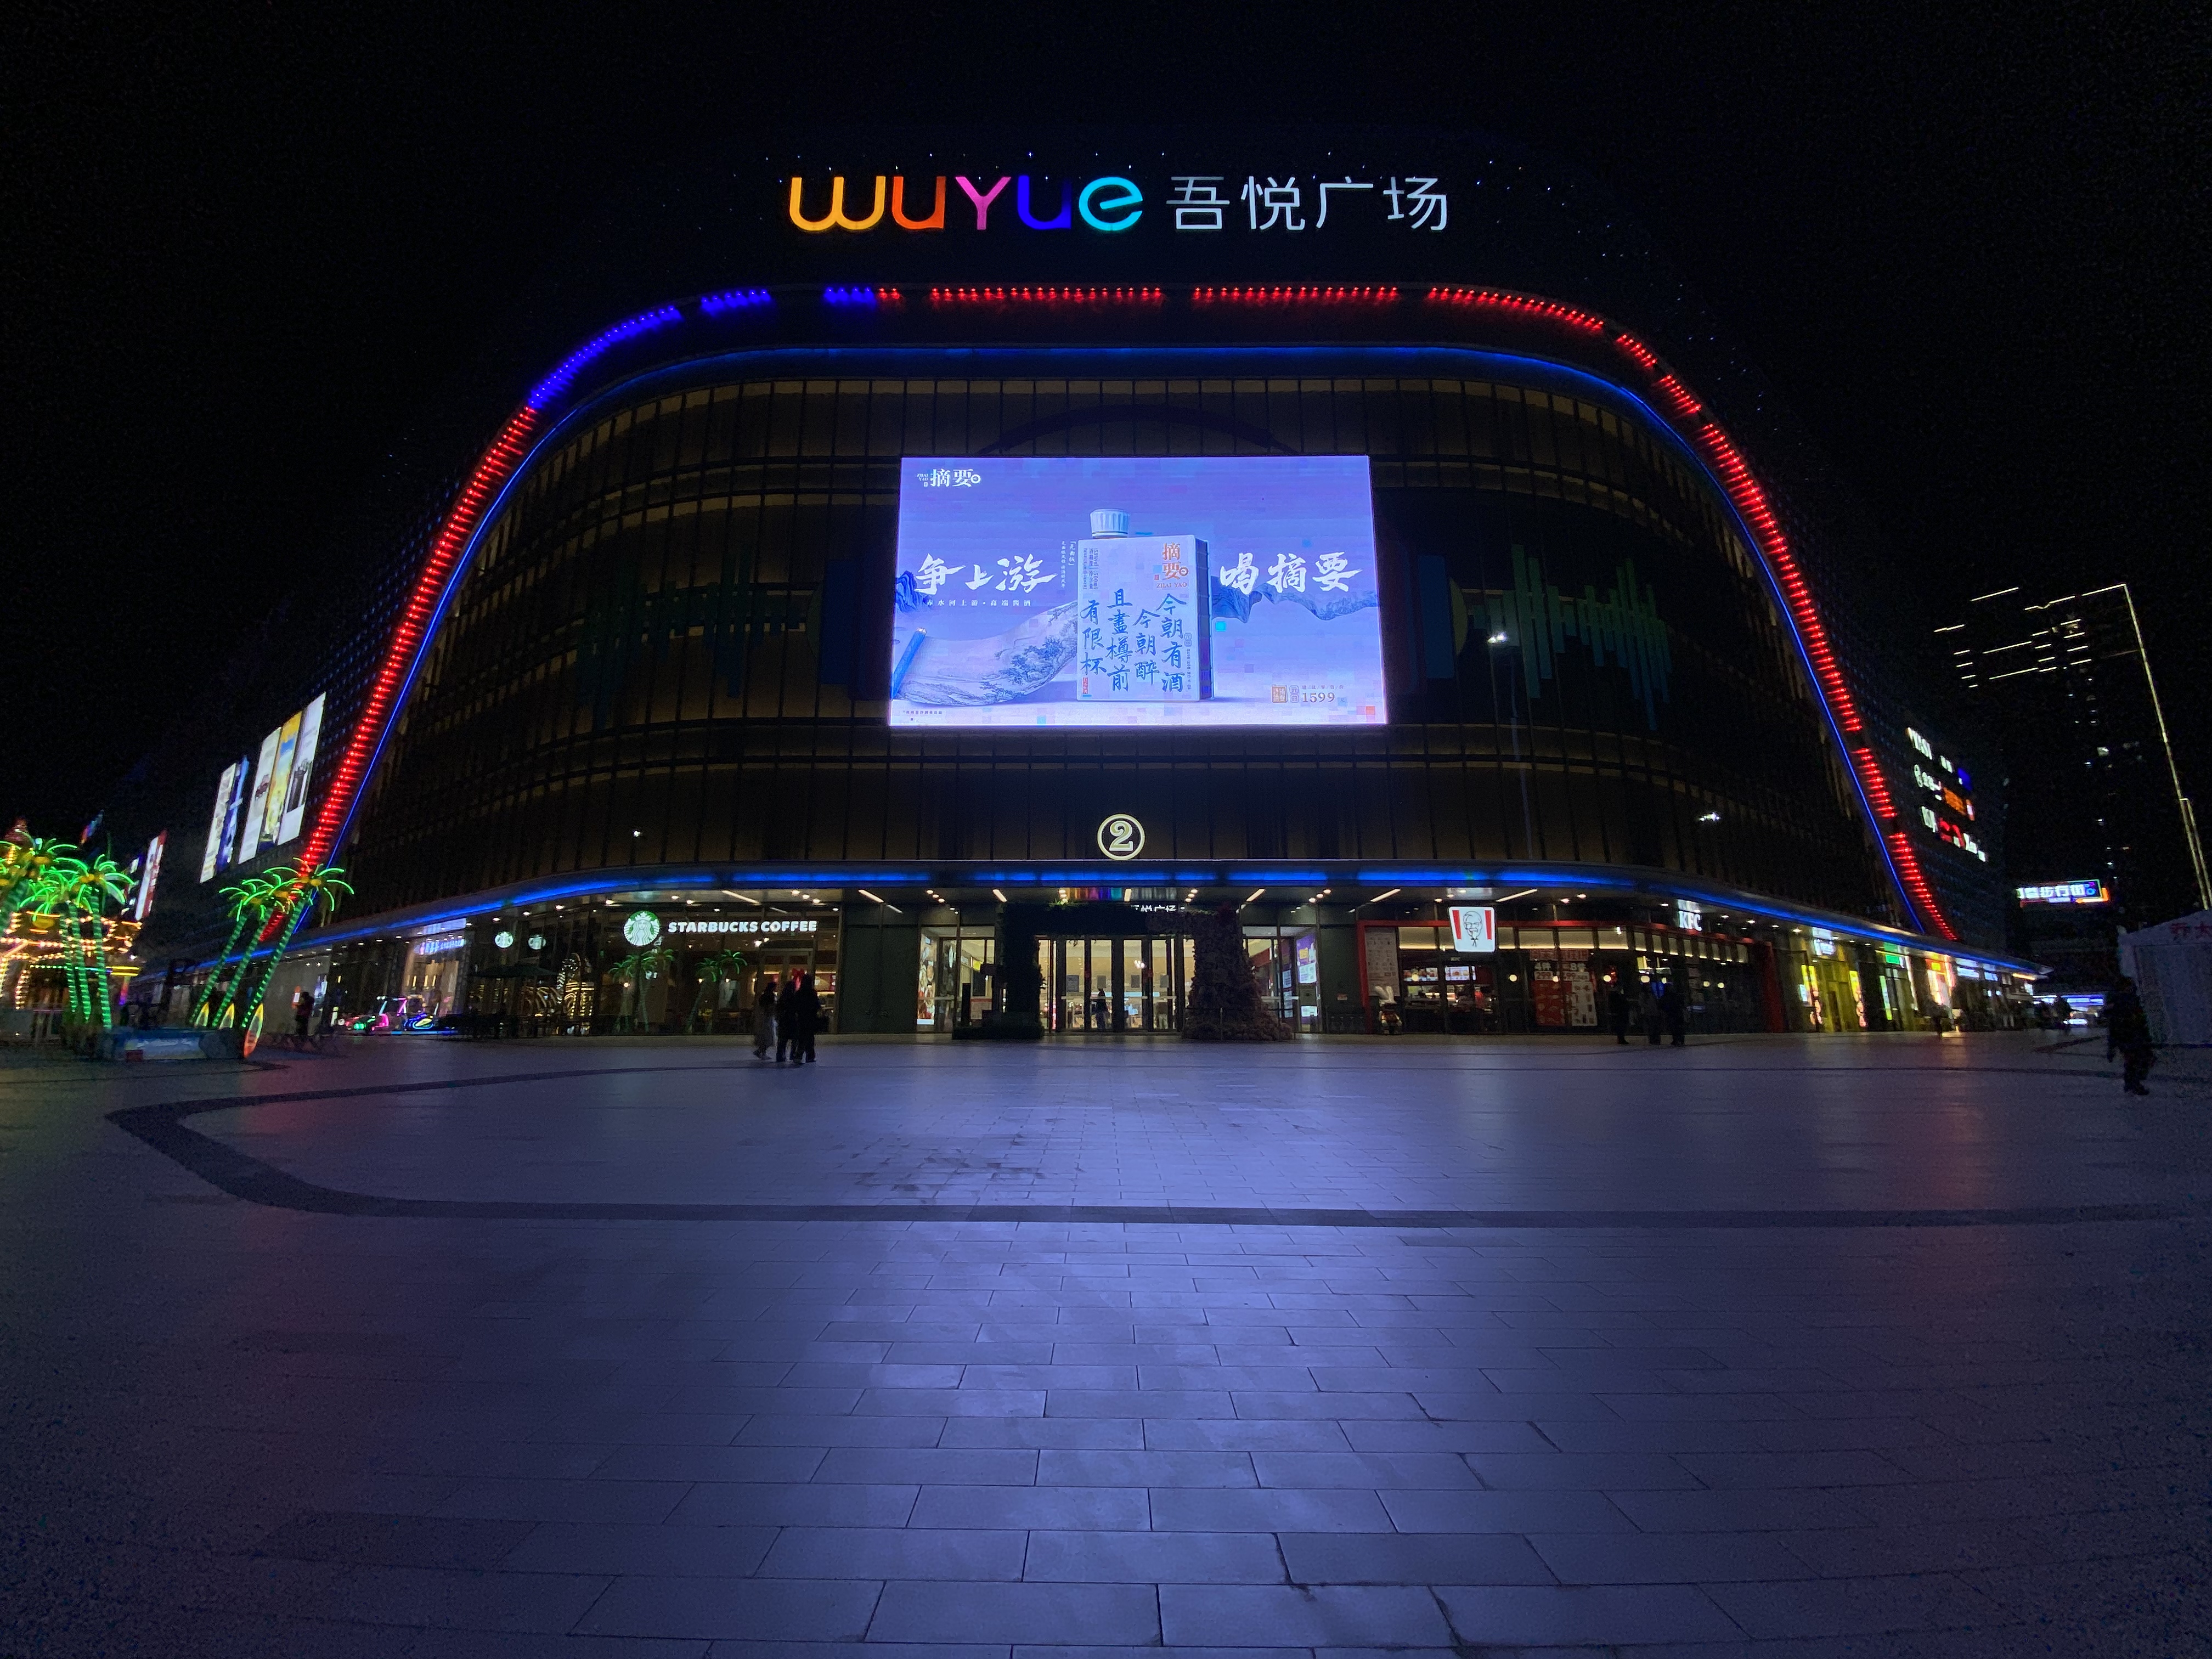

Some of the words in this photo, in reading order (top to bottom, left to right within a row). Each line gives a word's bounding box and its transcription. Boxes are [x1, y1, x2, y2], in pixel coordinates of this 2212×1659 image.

[1166, 176, 1449, 232] 吾悦广场
[930, 469, 974, 487] 摘要
[914, 553, 1058, 595] 争上游
[1162, 542, 1181, 580] 摘要
[1220, 552, 1363, 595] 喝摘要
[1080, 599, 1107, 675] 有限杯
[1132, 608, 1160, 686] 今朝醉
[1155, 593, 1187, 692] 今朝有酒
[1302, 692, 1335, 703] 1599
[1109, 820, 1133, 851] 2
[668, 922, 758, 933] STARBUCKS
[760, 921, 817, 932] COFFEE
[1678, 911, 1702, 932] KFC
